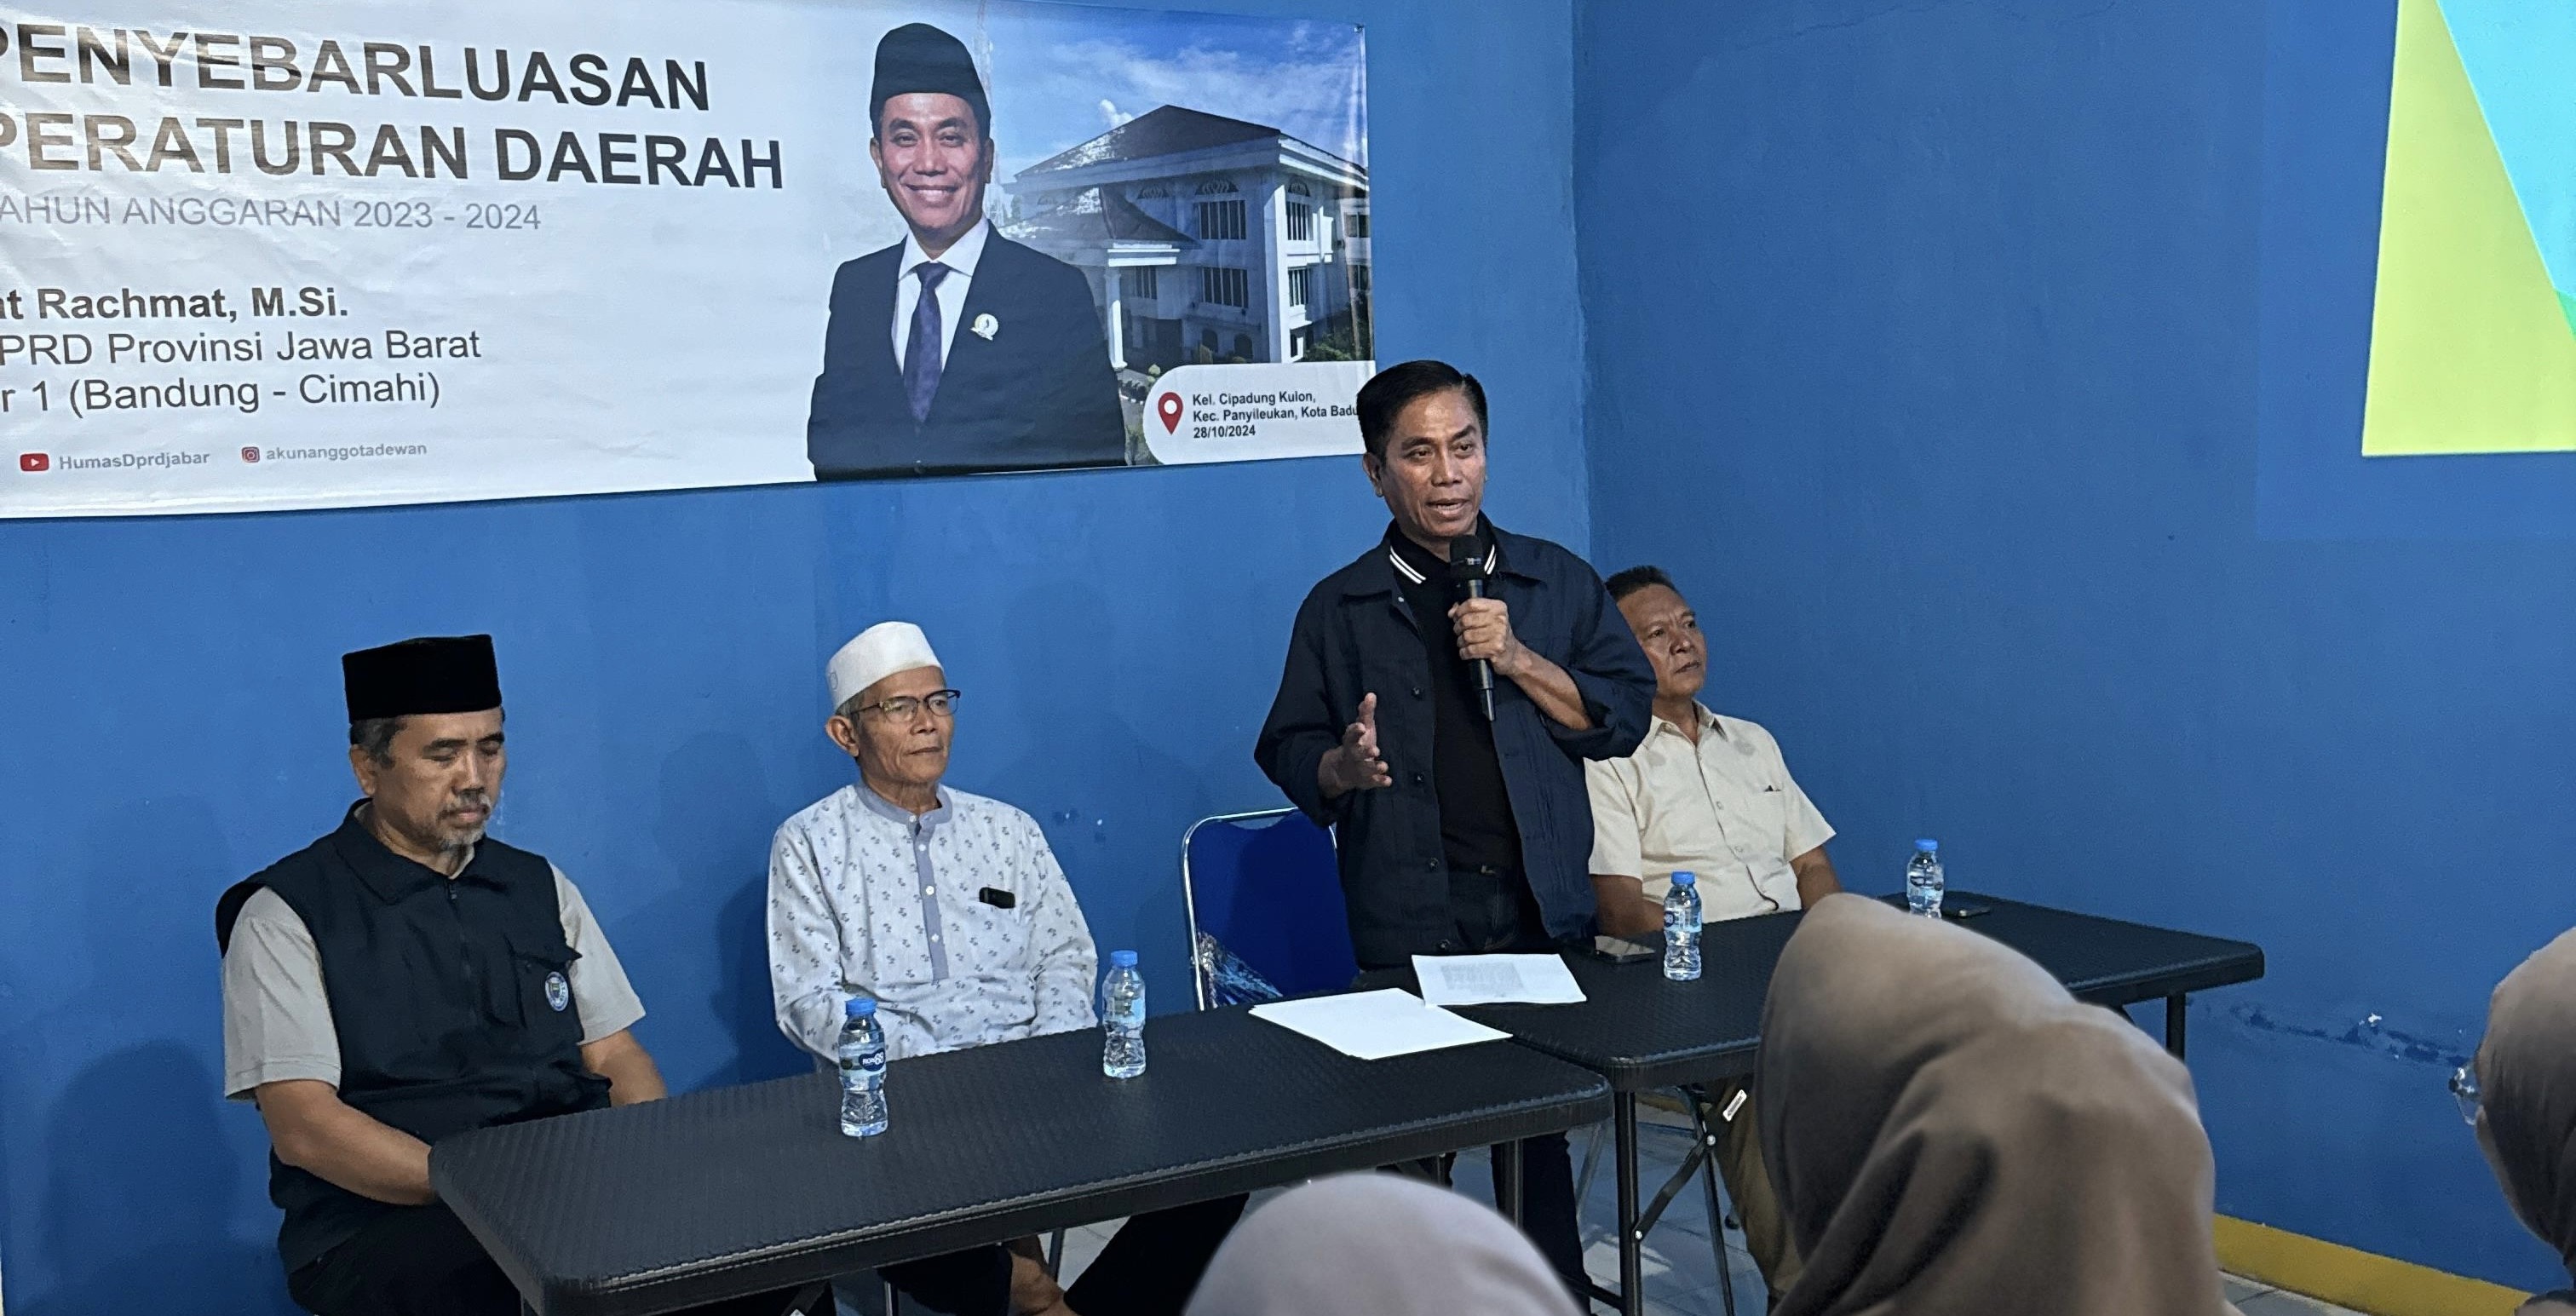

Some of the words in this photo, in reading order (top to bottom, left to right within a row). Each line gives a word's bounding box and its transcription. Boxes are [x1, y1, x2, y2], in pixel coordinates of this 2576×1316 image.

[495, 128, 783, 189] DAERAH
[122, 197, 341, 227] ANGGARAN
[353, 200, 433, 228] 2023
[466, 203, 541, 230] 2024
[0, 289, 25, 320] t
[37, 288, 237, 324] Rachmat,
[251, 286, 348, 317] M.Si.
[108, 331, 262, 364] Provinsi
[276, 330, 373, 361] Jawa
[385, 330, 481, 359] Barat
[32, 380, 49, 411] 1
[70, 376, 259, 419] (Bandung
[299, 371, 440, 409] Cimahi)
[1193, 394, 1216, 406] Kel.
[1219, 392, 1276, 407] Cipadung
[1279, 390, 1316, 403] Kulon,
[1193, 410, 1220, 422] Kec.
[1222, 407, 1298, 423] Panyileukan,
[1301, 405, 1327, 417] Kota
[1193, 424, 1256, 439] 28/10/2024
[59, 451, 210, 470] HumasDprdjabar
[266, 443, 428, 462] akunanggotadewan
